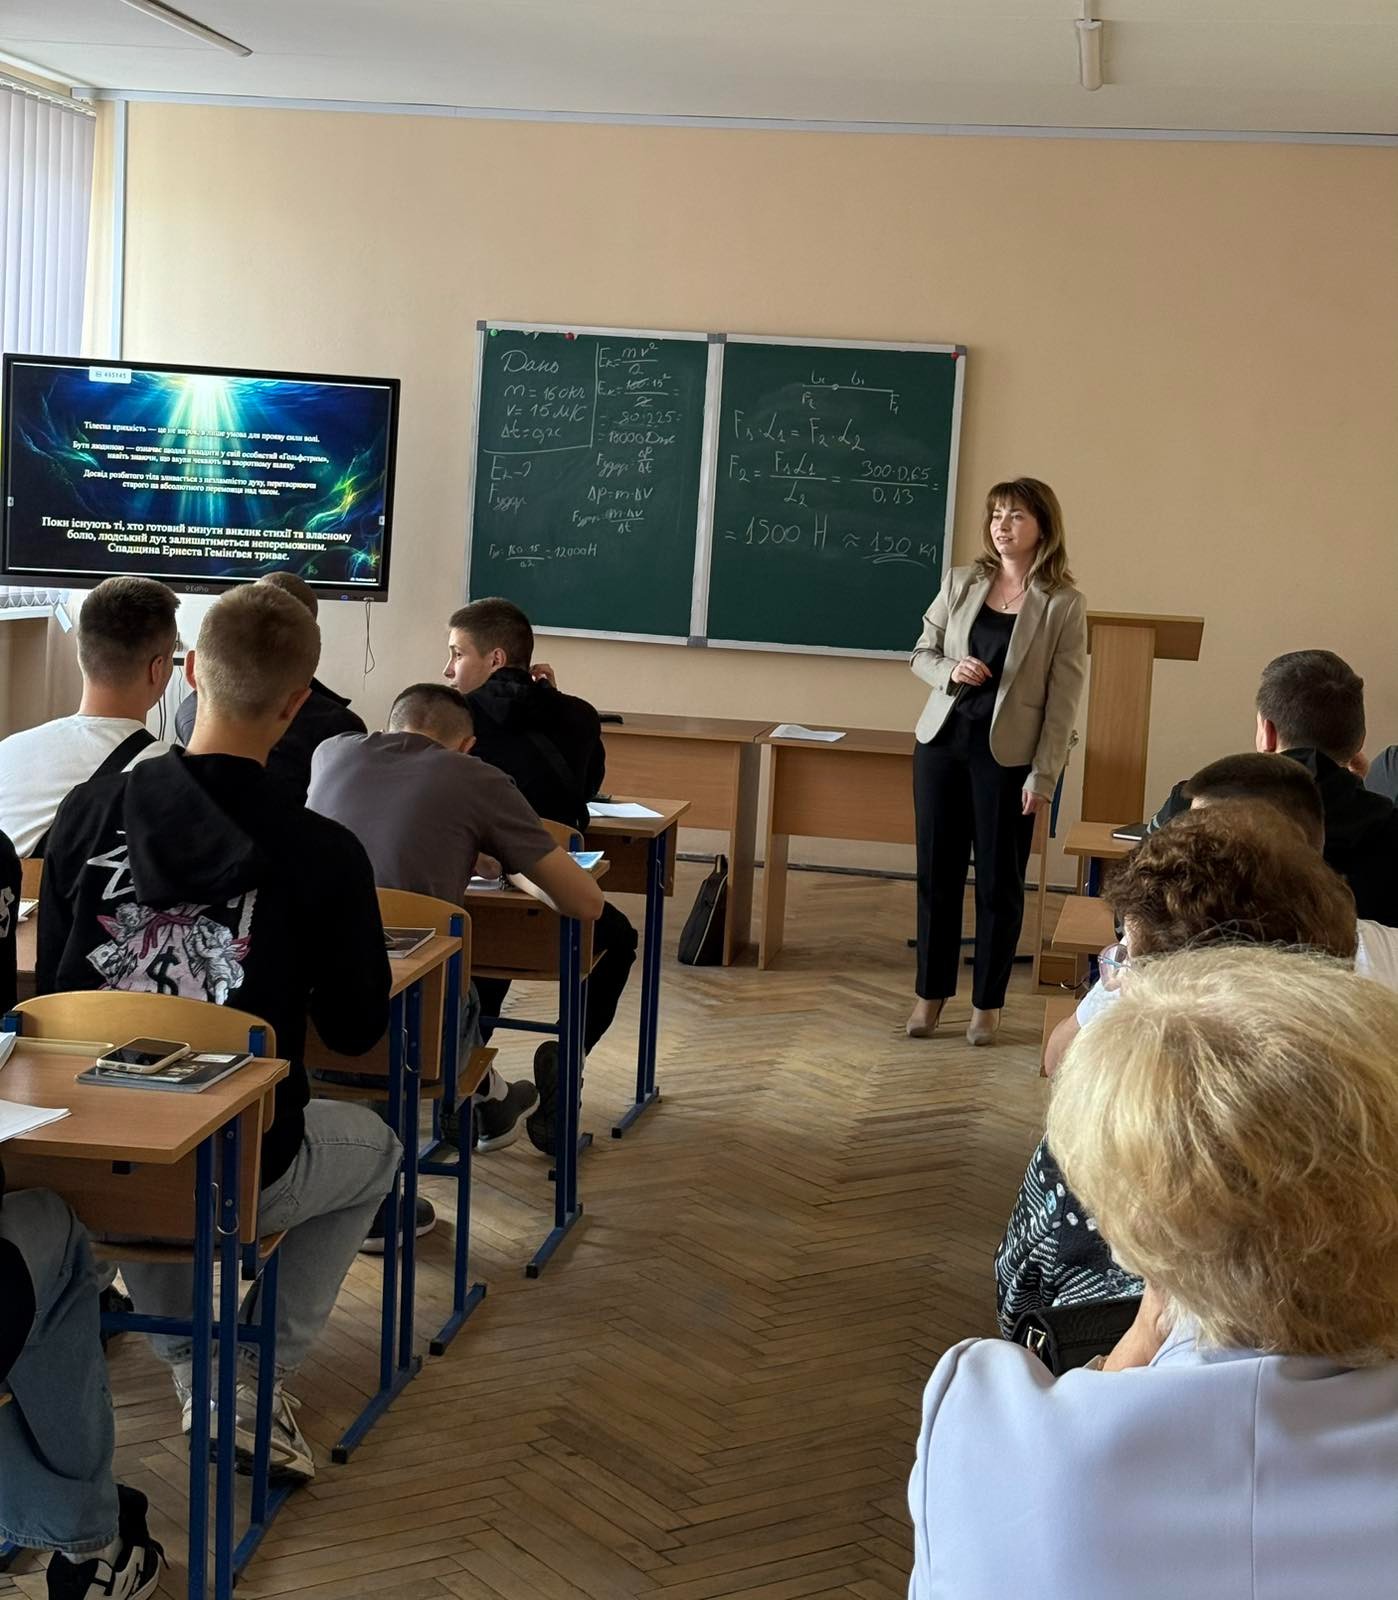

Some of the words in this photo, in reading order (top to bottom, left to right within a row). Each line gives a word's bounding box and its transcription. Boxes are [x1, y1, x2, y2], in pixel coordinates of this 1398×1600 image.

[42, 516, 70, 528] Поки
[71, 517, 112, 530] існують
[113, 520, 126, 531] ті,
[127, 522, 144, 532] хто
[145, 523, 186, 534] готовий
[187, 525, 224, 537] кинути
[225, 527, 262, 538] виклик
[262, 528, 292, 540] стихії
[293, 531, 304, 540] та
[305, 531, 352, 544] власному
[66, 529, 97, 541] болю,
[97, 531, 148, 543] людський
[149, 533, 168, 544] дух
[168, 535, 250, 548] залишатиметься
[251, 539, 327, 552] непереможним.
[107, 543, 161, 555] Спадщина
[162, 545, 203, 558] Ернеста
[204, 546, 252, 560] Гемінґвея
[252, 549, 290, 562] триває.
